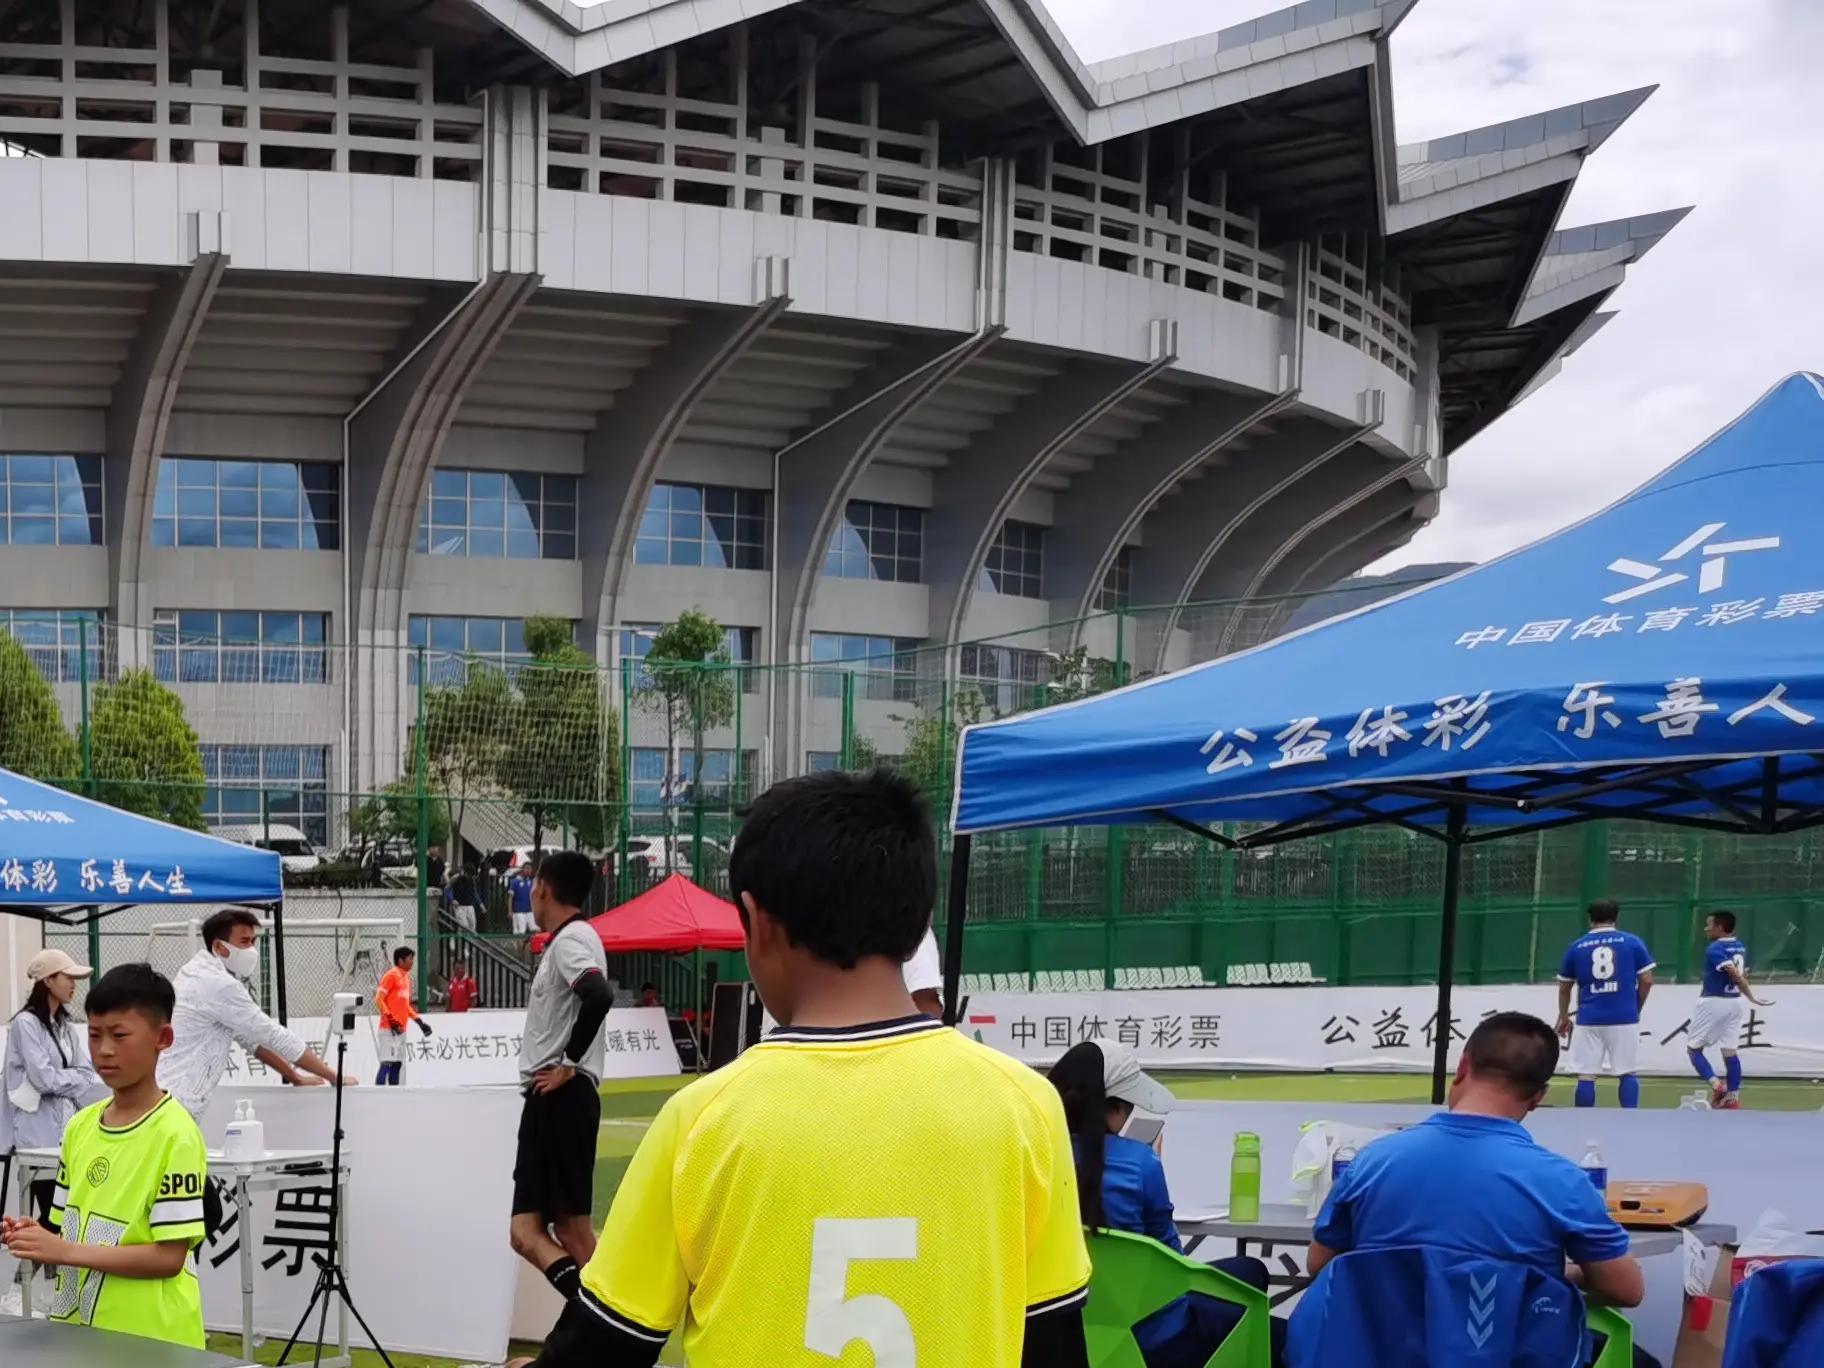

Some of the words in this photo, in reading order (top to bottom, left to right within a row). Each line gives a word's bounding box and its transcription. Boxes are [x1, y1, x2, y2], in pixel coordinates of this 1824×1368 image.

[1456, 591, 1824, 652] 中国体育彩票
[1199, 689, 1494, 775] 公益体彩
[80, 859, 193, 895] 乐善人生
[1592, 946, 1614, 980] 8
[606, 1028, 660, 1053] 暖有光
[1011, 1015, 1221, 1049] 中国体育彩票
